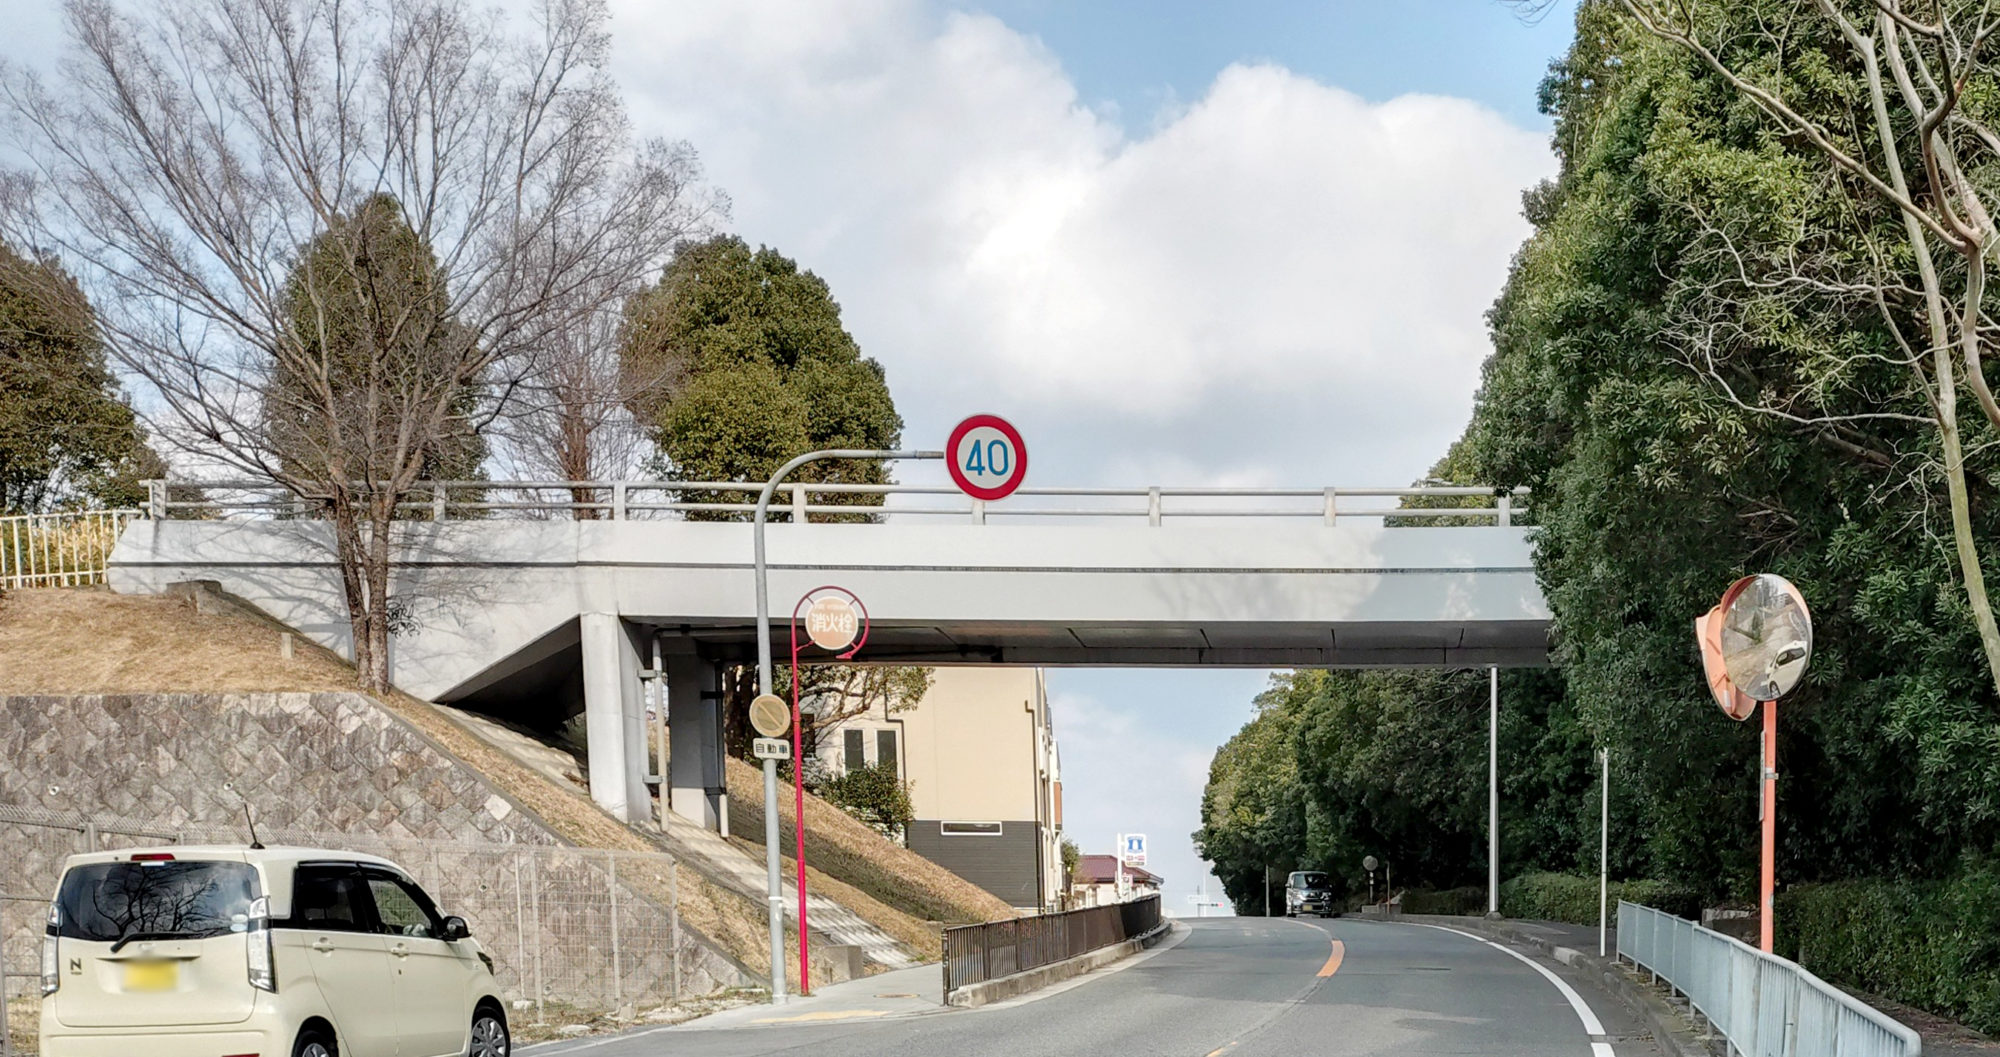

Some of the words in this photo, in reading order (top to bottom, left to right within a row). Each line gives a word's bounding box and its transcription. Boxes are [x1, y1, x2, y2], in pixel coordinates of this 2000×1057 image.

[965, 439, 1009, 476] 40
[811, 612, 853, 633] 消火栓
[755, 743, 787, 754] 自動車
